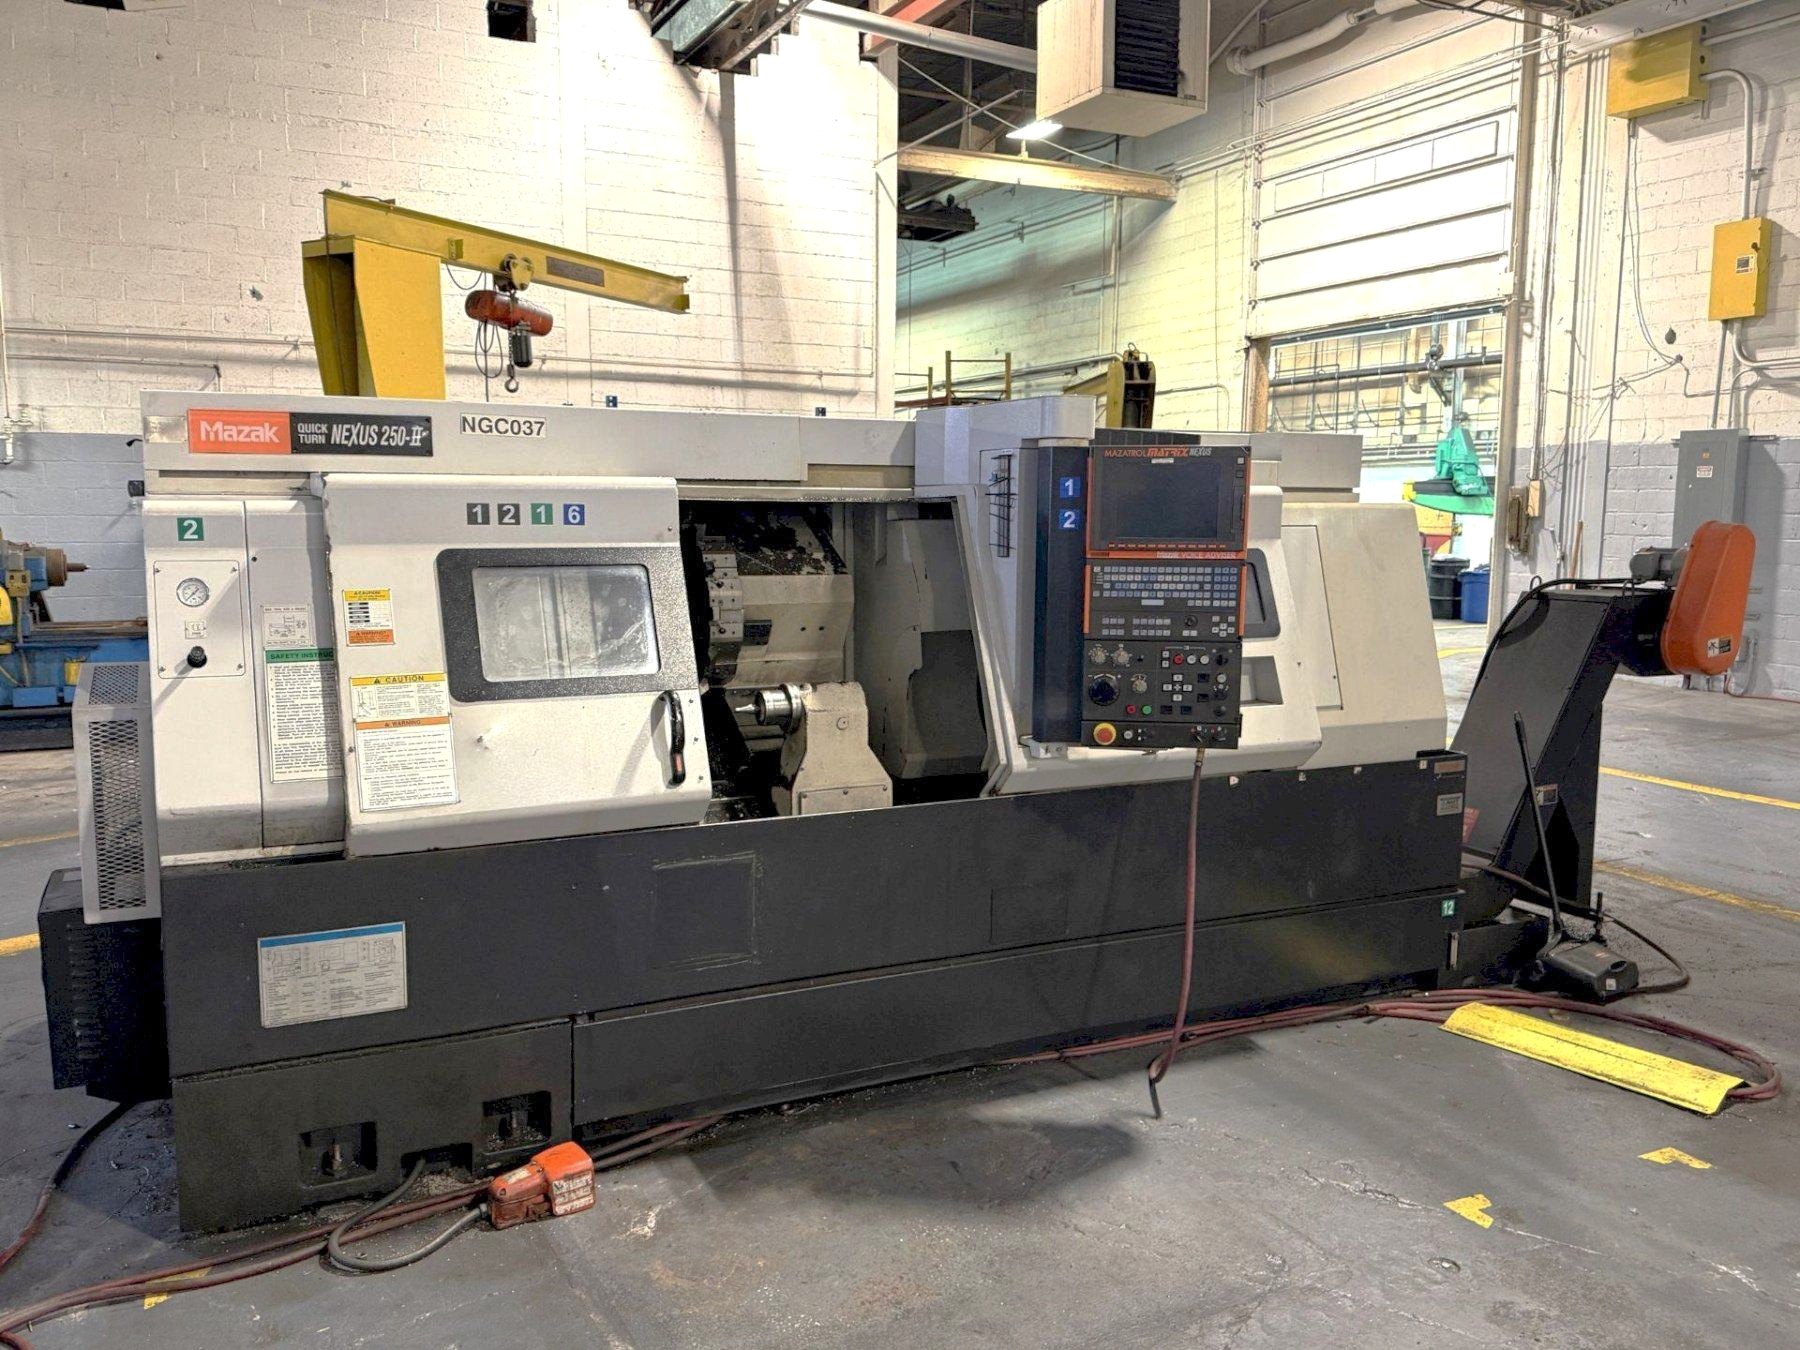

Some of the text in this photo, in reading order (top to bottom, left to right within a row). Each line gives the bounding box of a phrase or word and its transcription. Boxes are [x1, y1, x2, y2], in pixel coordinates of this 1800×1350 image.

[200, 420, 280, 443] Mazak
[297, 422, 328, 434] QUICK
[461, 416, 546, 436] NGC037
[298, 434, 326, 444] TURN
[330, 422, 379, 447] NEXUS
[1104, 449, 1147, 457] MAZATROL
[1189, 447, 1212, 457] NEXUS
[1064, 478, 1074, 496] 1
[1063, 511, 1076, 528] 2
[183, 519, 199, 539] 2
[270, 652, 299, 660] SAFETY
[385, 675, 424, 684] CAUTION
[392, 719, 421, 727] WARNING
[1443, 900, 1454, 915] 12
